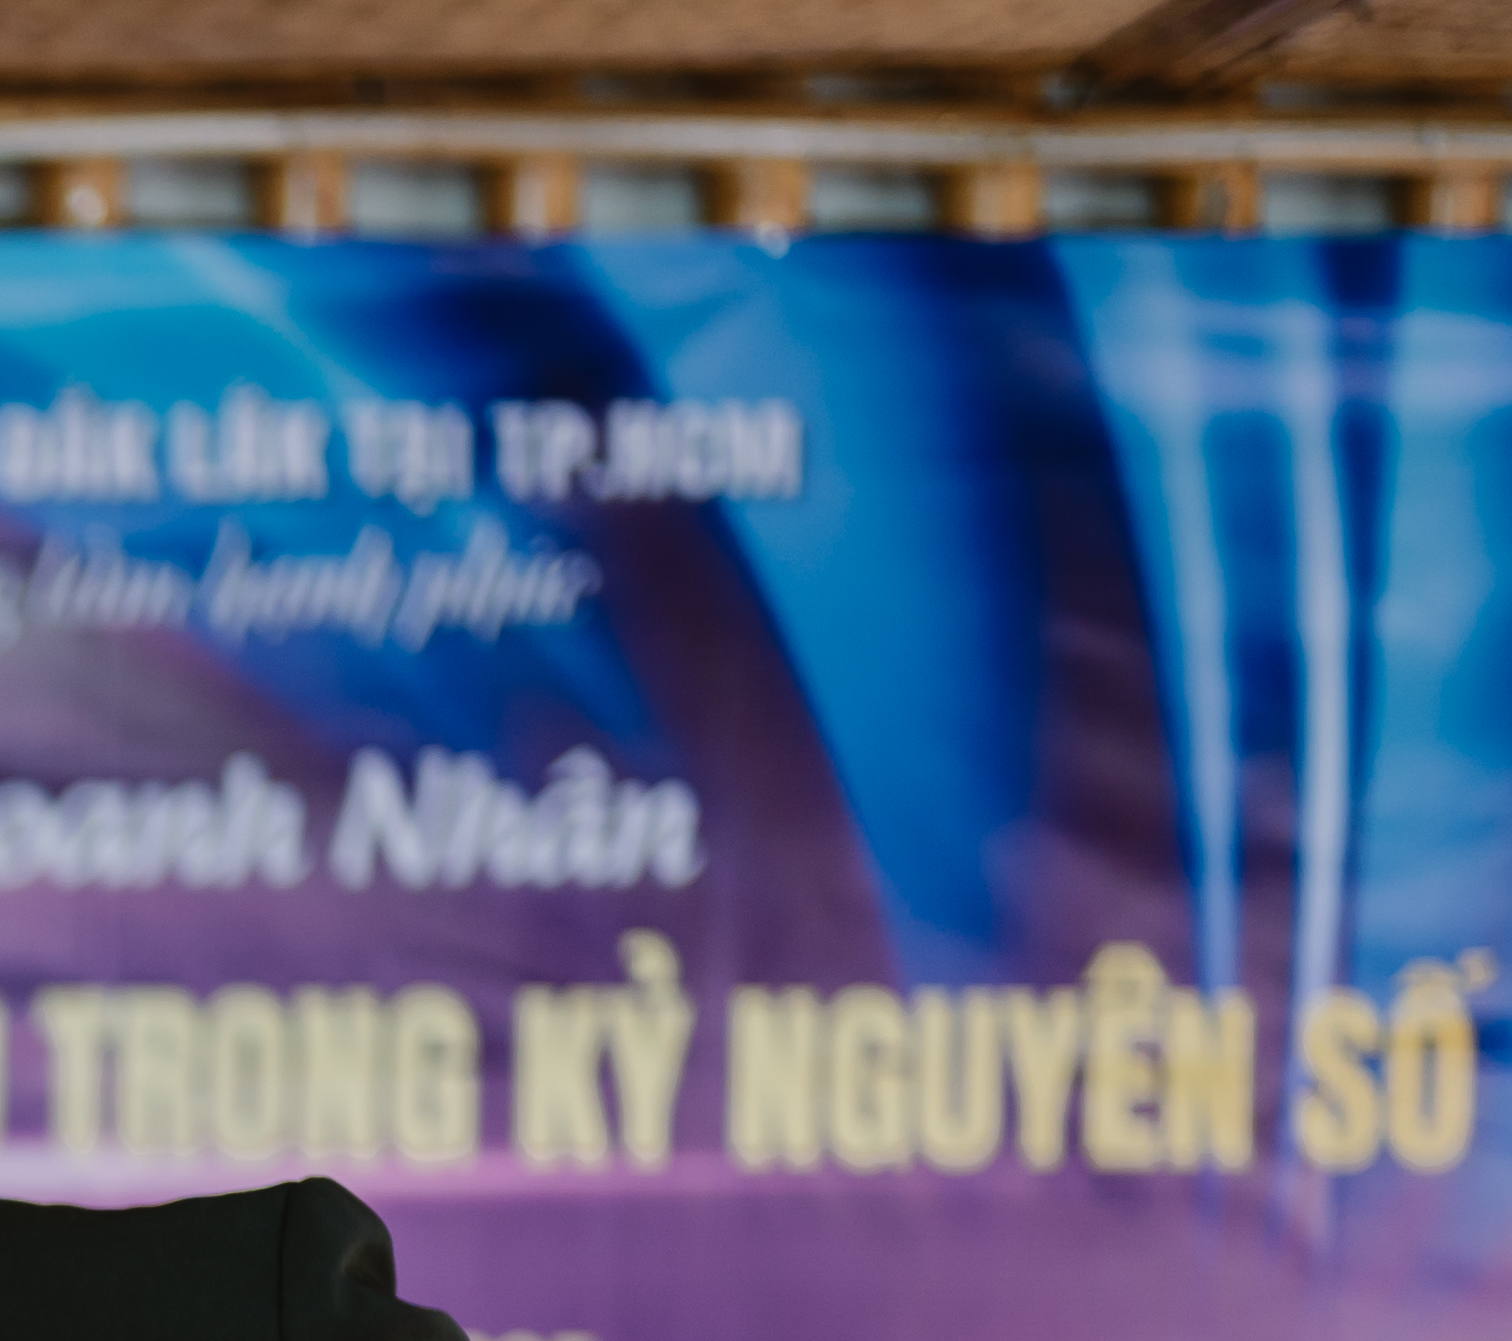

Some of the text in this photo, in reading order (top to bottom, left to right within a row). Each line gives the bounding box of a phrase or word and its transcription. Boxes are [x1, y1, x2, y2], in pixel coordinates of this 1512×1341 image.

[352, 400, 474, 516] TẠI
[491, 399, 804, 503] TP.HCM
[328, 745, 707, 894] Nhân
[38, 984, 482, 1167] TRONG
[726, 942, 1255, 1172] NGUYÊN
[1297, 947, 1498, 1174] SỐ
